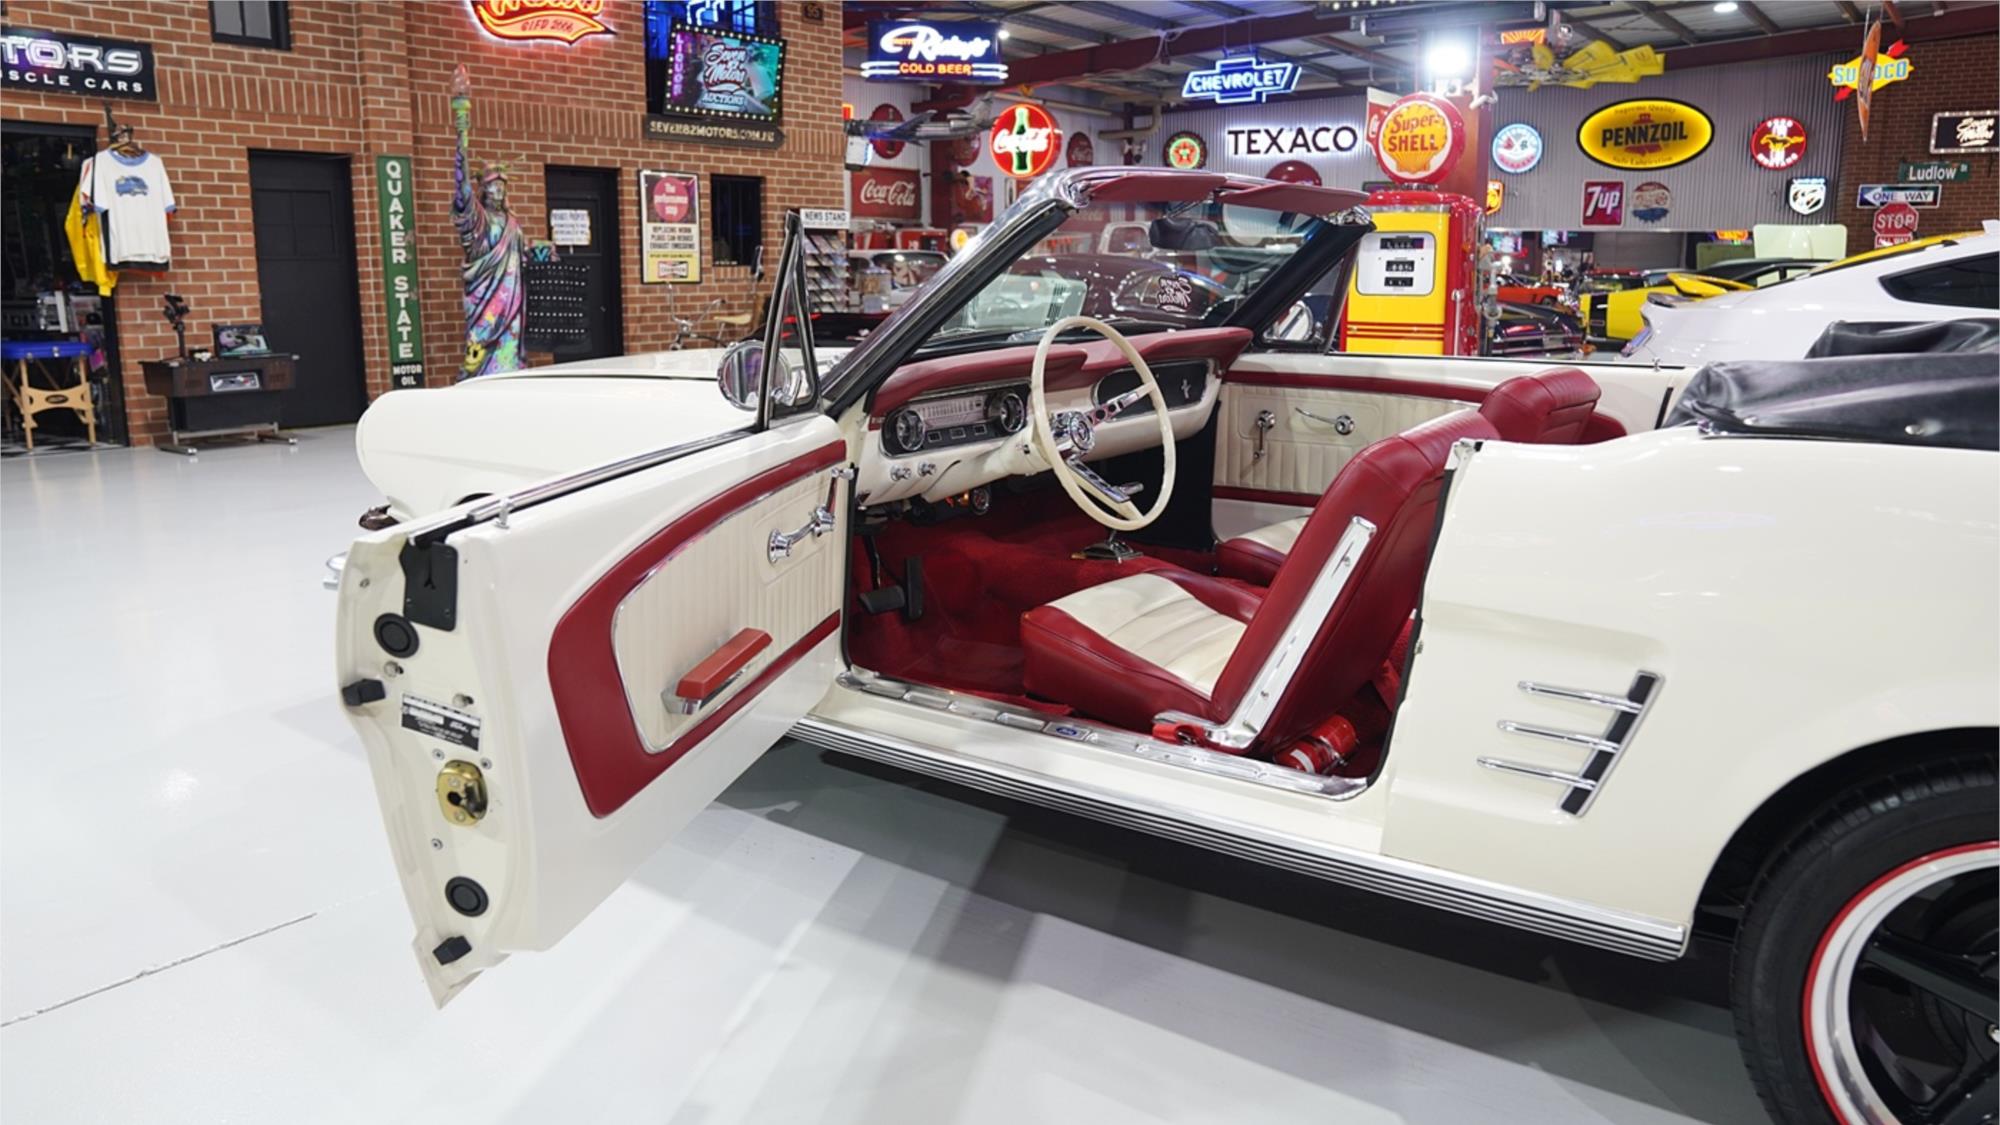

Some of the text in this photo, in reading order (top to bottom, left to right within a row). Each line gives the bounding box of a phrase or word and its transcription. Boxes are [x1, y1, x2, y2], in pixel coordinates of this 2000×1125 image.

[900, 63, 972, 75] COLD BEER
[1834, 61, 1907, 83] SUOCO
[0, 70, 143, 93] SCLE CARS
[1191, 70, 1283, 92] CHEVROLET
[1228, 126, 1358, 155] TEXACO
[1388, 134, 1439, 152] SHELL
[1602, 121, 1688, 148] PENNZOIL
[1908, 165, 1957, 180] Ludlow
[1905, 193, 1930, 201] WAY
[386, 160, 407, 264] QUAKER
[825, 212, 846, 221] STAND
[1877, 214, 1914, 229] STOP
[394, 275, 413, 358] STATE
[392, 364, 422, 375] MOTOR
[401, 376, 416, 386] OIL
